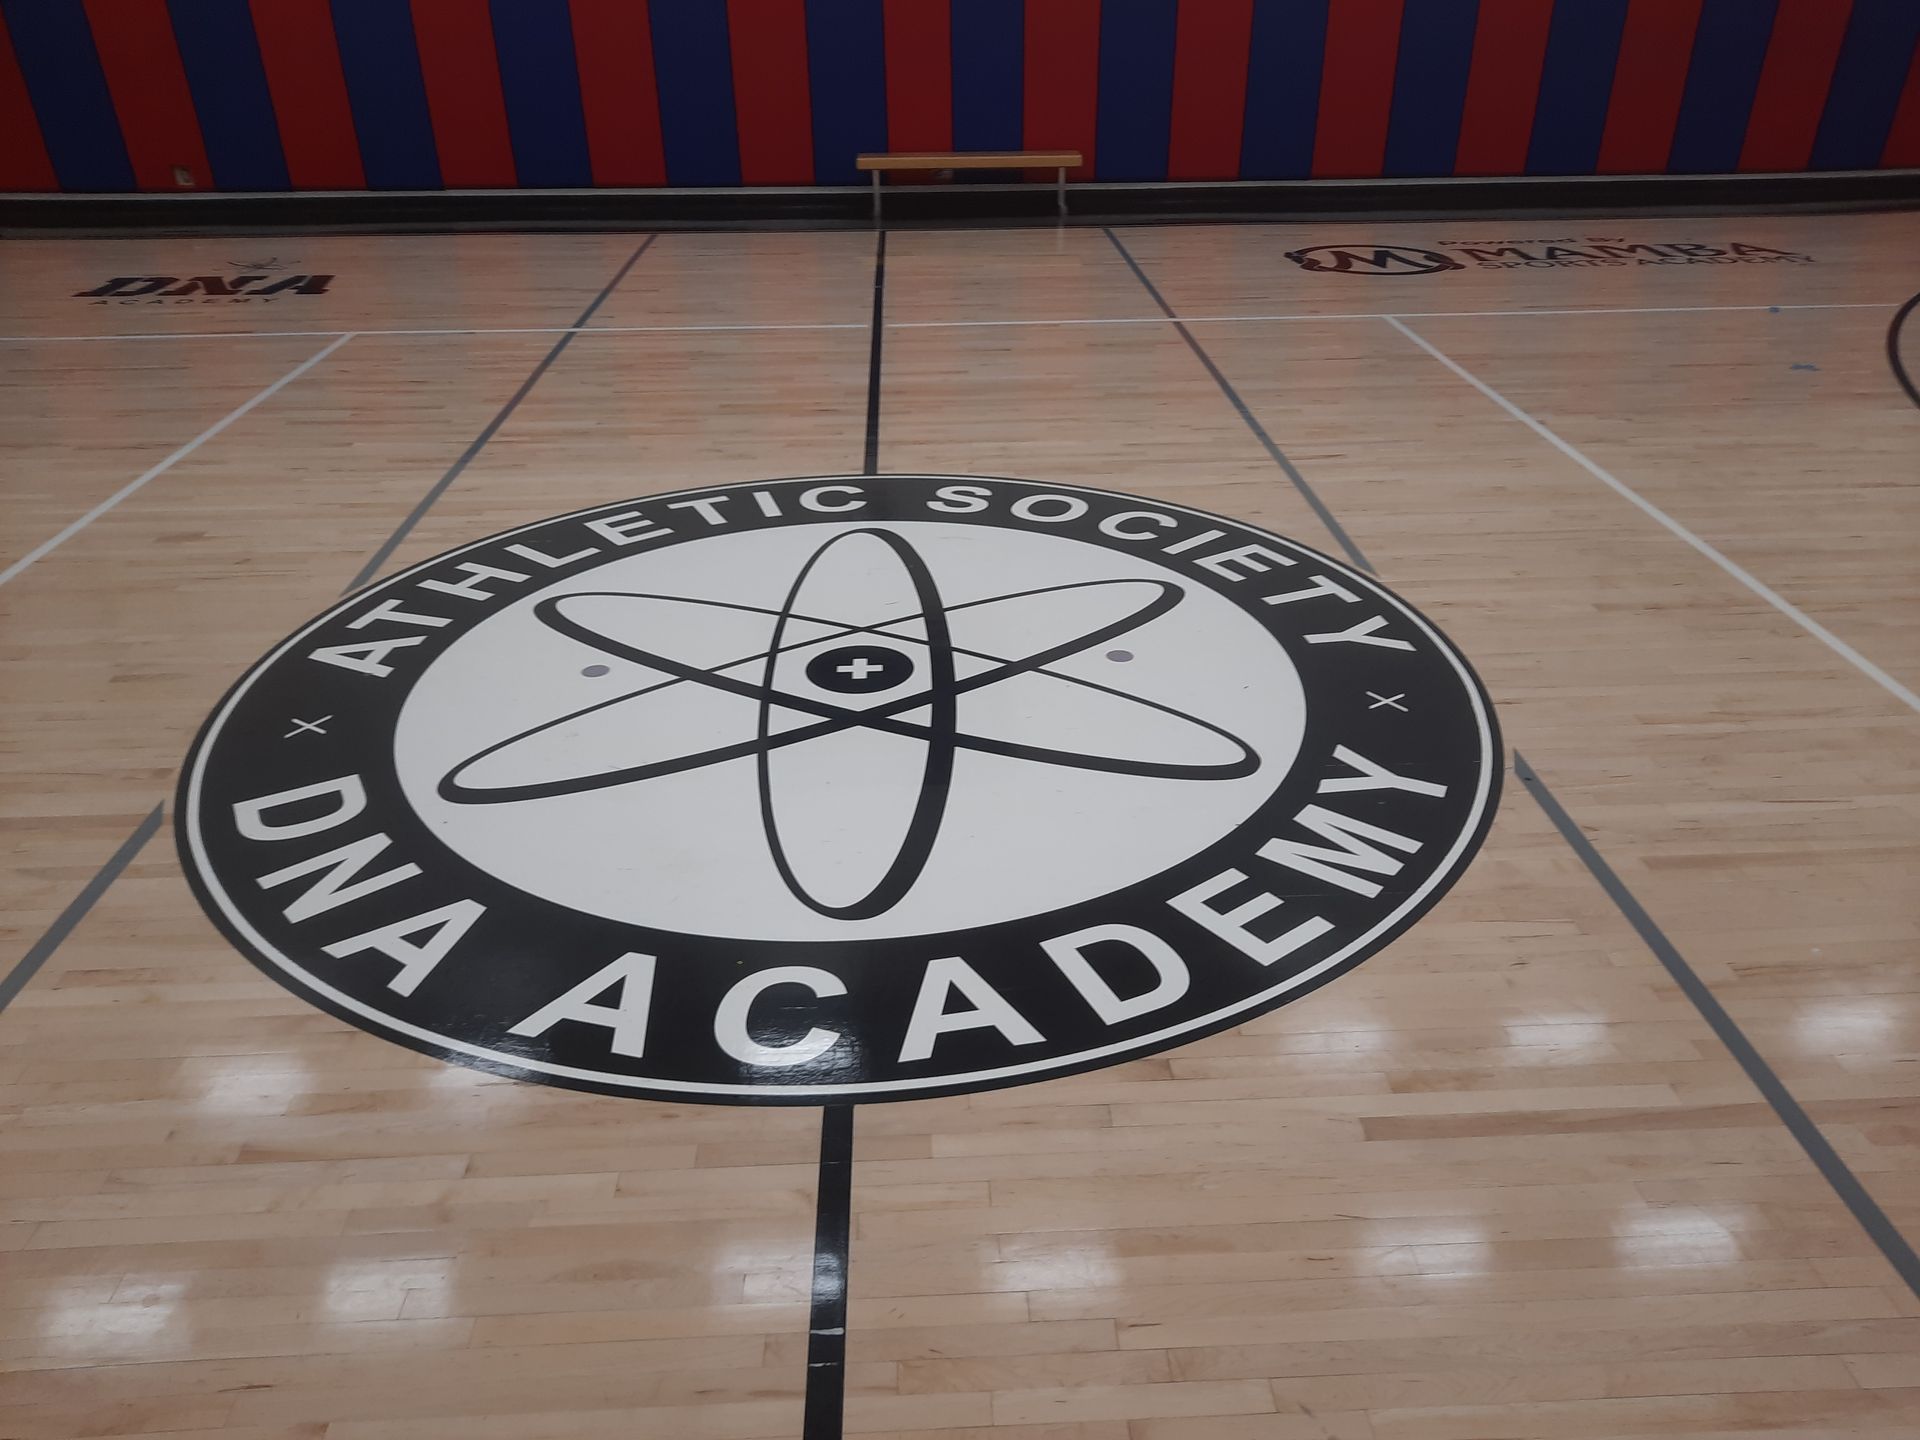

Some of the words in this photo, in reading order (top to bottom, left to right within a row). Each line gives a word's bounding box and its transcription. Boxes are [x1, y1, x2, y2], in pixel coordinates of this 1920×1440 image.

[1450, 242, 1801, 262] MAMBA
[1475, 259, 1628, 270] SPORTS
[1637, 255, 1816, 266] ACADEMY
[71, 274, 336, 298] DNA
[307, 485, 867, 679] ATHLETIC
[926, 485, 1418, 654] SOCIETY
[232, 773, 488, 999] DNA
[505, 743, 1448, 1067] ACADEMY
